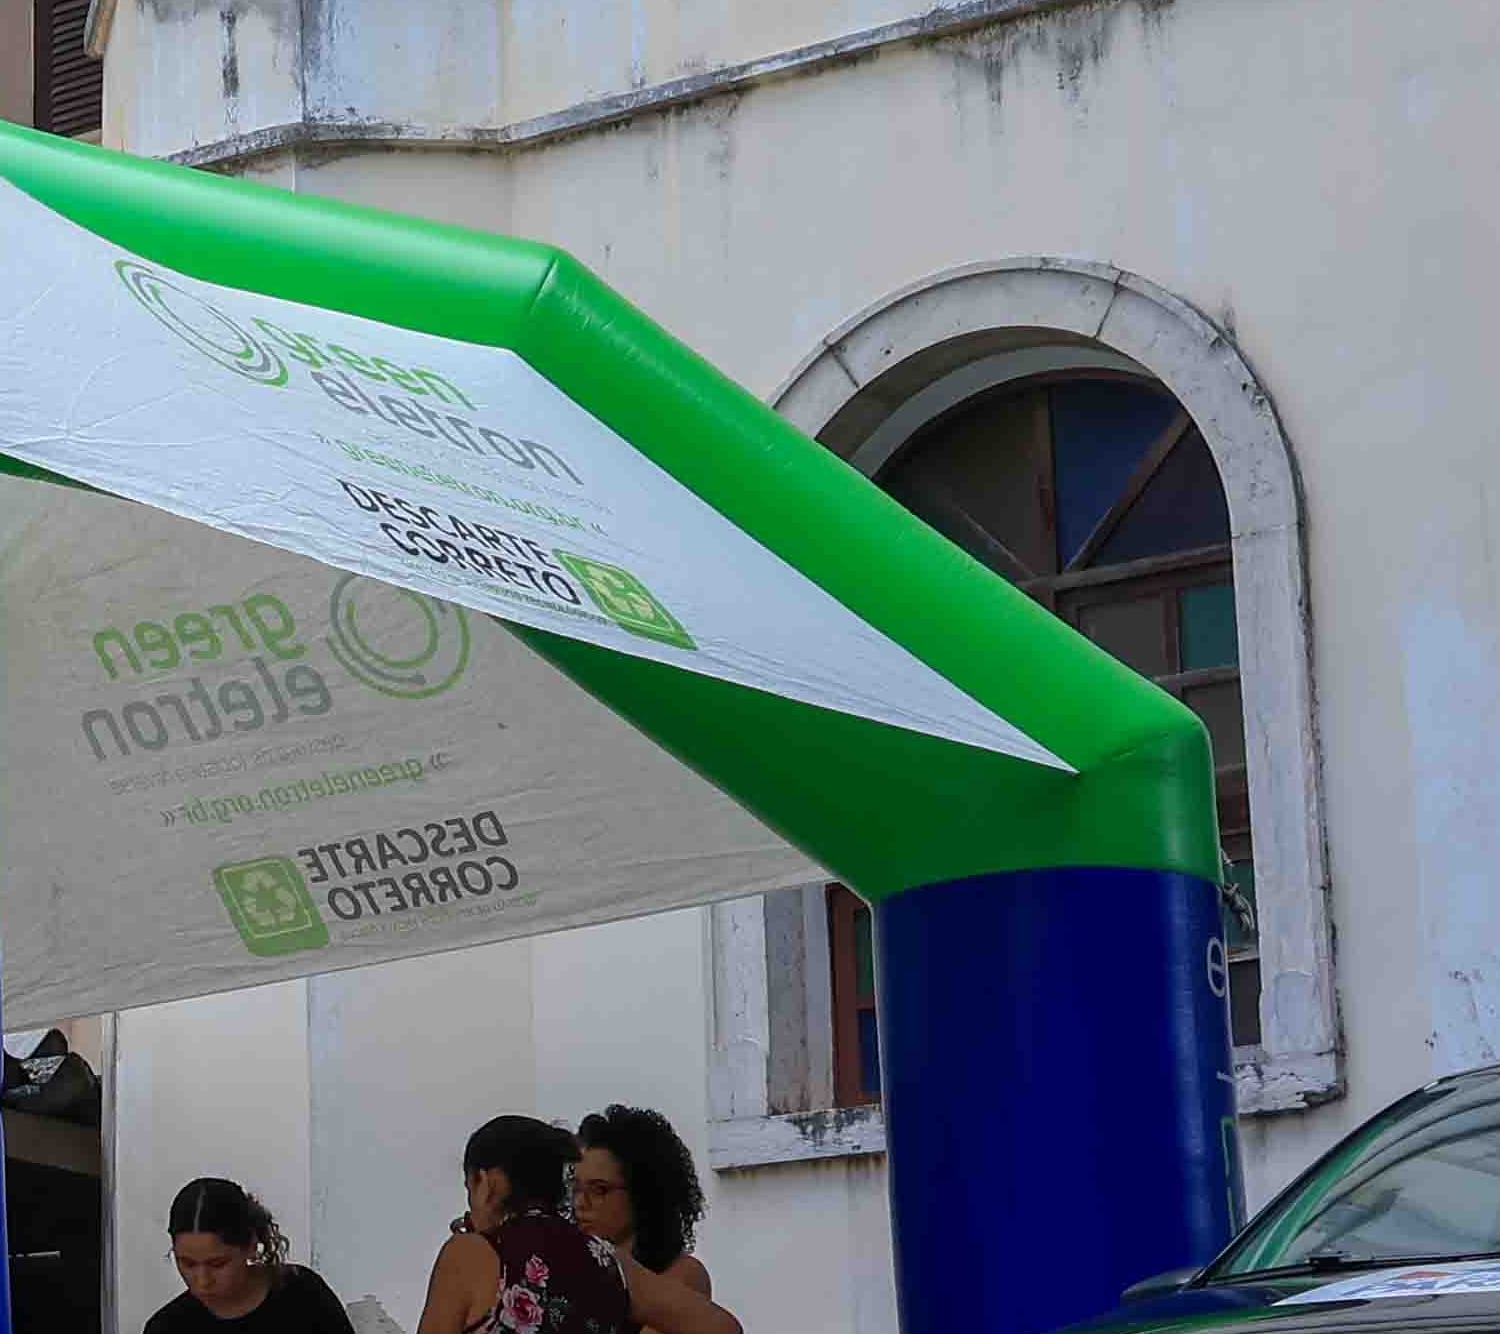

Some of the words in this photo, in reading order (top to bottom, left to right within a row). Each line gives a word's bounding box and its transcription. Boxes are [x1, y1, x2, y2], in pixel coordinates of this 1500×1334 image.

[252, 317, 476, 411] green
[311, 371, 584, 485] eletron
[336, 478, 560, 569] DESCARTE
[380, 522, 581, 606] CORRETO
